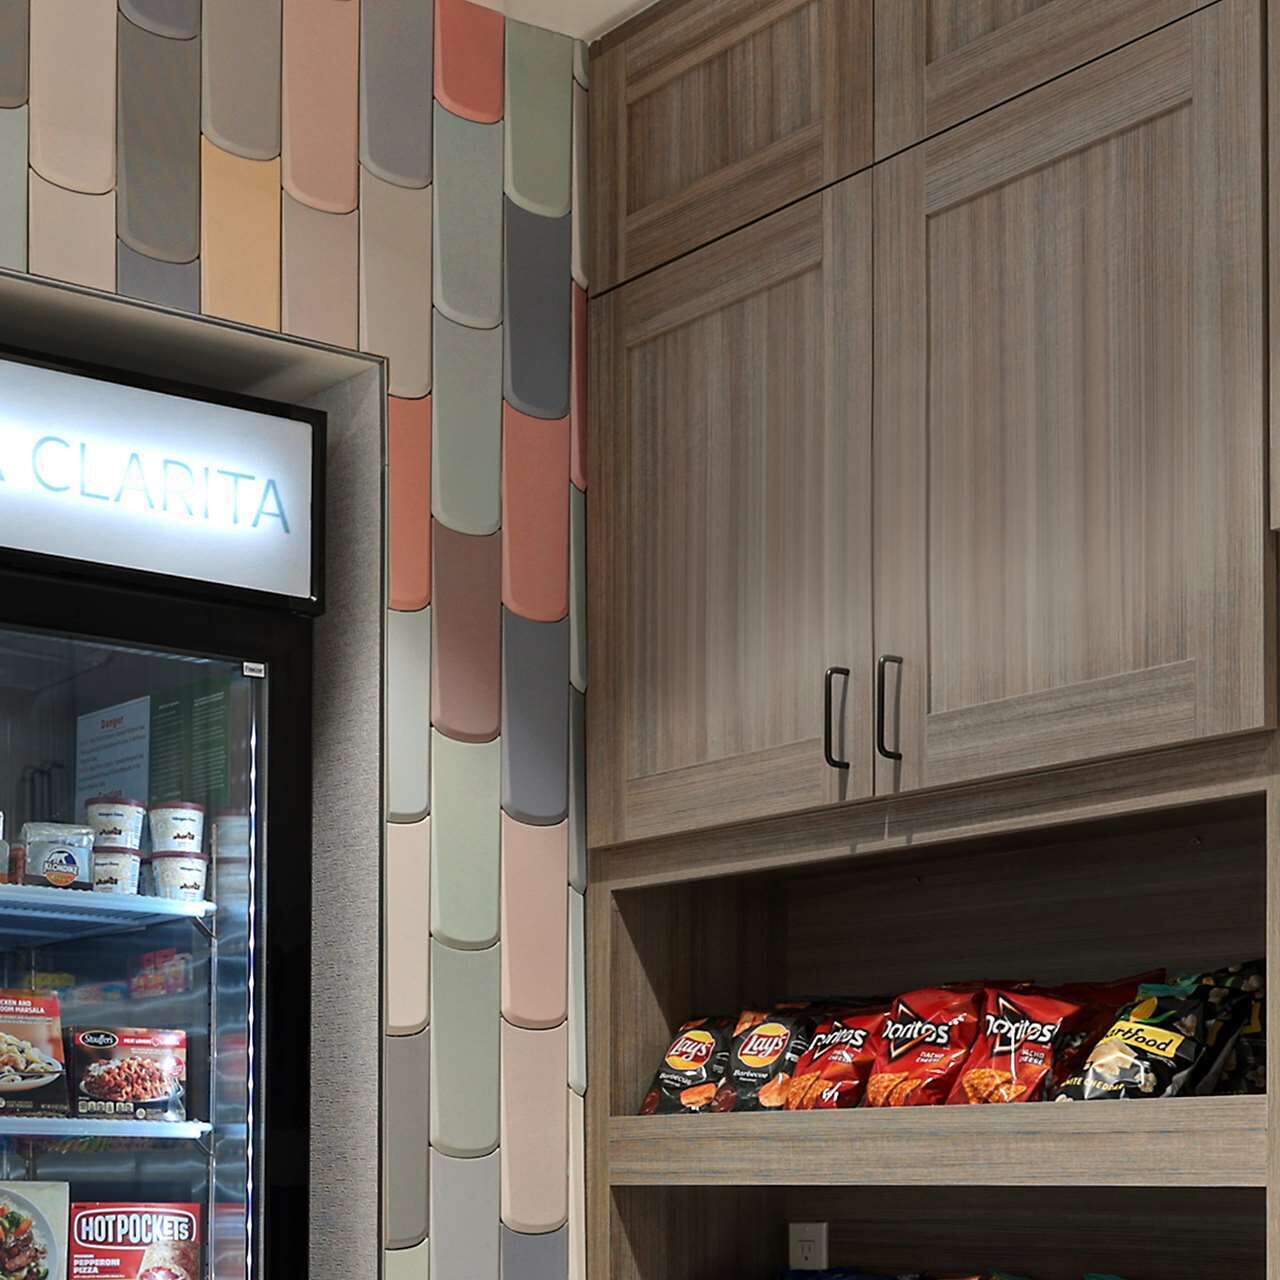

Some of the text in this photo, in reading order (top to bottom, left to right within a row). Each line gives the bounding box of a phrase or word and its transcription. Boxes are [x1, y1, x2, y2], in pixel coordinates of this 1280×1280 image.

[31, 435, 291, 535] CLARITA
[42, 861, 80, 875] KLONDIKE
[13, 1006, 45, 1014] MARSALA
[84, 1033, 116, 1046] Stouffer's
[883, 1020, 950, 1043] Doritos
[986, 1015, 1055, 1043] Doritos
[671, 1036, 712, 1060] Lay's
[743, 1033, 788, 1059] Lay's
[733, 1069, 769, 1079] Barbecue
